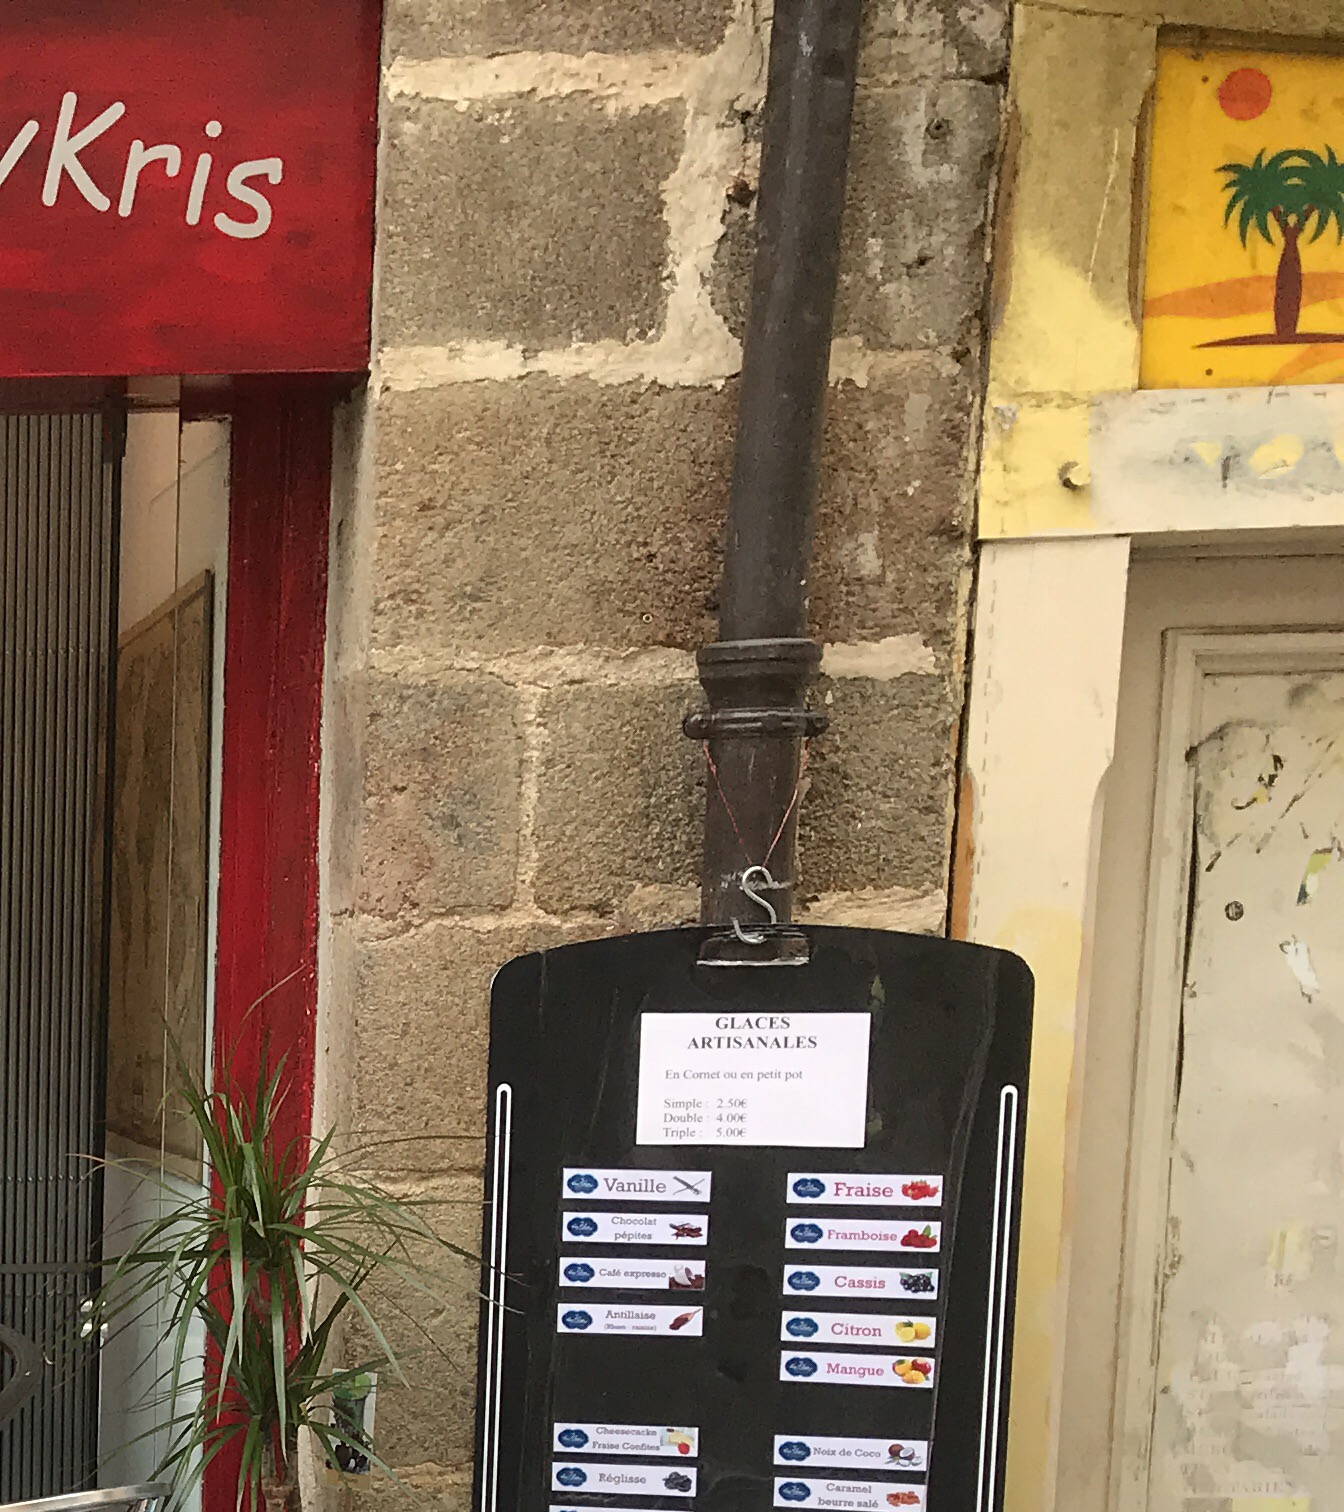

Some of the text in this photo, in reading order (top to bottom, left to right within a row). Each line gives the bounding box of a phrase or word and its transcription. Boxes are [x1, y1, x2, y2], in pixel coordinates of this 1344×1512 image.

[715, 1016, 791, 1030] GLACES
[687, 1036, 818, 1050] ARTISANALES
[665, 1070, 680, 1080] En
[723, 1071, 738, 1080] ou
[740, 1071, 754, 1080] en
[757, 1069, 782, 1082] petit
[785, 1070, 804, 1082] pot
[664, 1099, 703, 1110] Simple
[664, 1113, 747, 1123] Double 4.00€
[663, 1127, 747, 1139] Triple 5.00€
[603, 1177, 667, 1194] Vanille
[834, 1182, 894, 1198] Fraise
[611, 1216, 657, 1226] Chocolat
[614, 1231, 652, 1242] pépites
[827, 1229, 898, 1242] Framboise
[598, 1269, 666, 1280] Café expresso
[834, 1276, 886, 1290] Cassis
[605, 1310, 656, 1320] Antillaise
[831, 1322, 882, 1338] Citron
[826, 1363, 885, 1379] Mangue
[813, 1447, 881, 1458] Noix de Coco
[598, 1473, 646, 1485] Réglisse
[826, 1483, 872, 1494] Caramel
[817, 1497, 879, 1509] beurre salé
